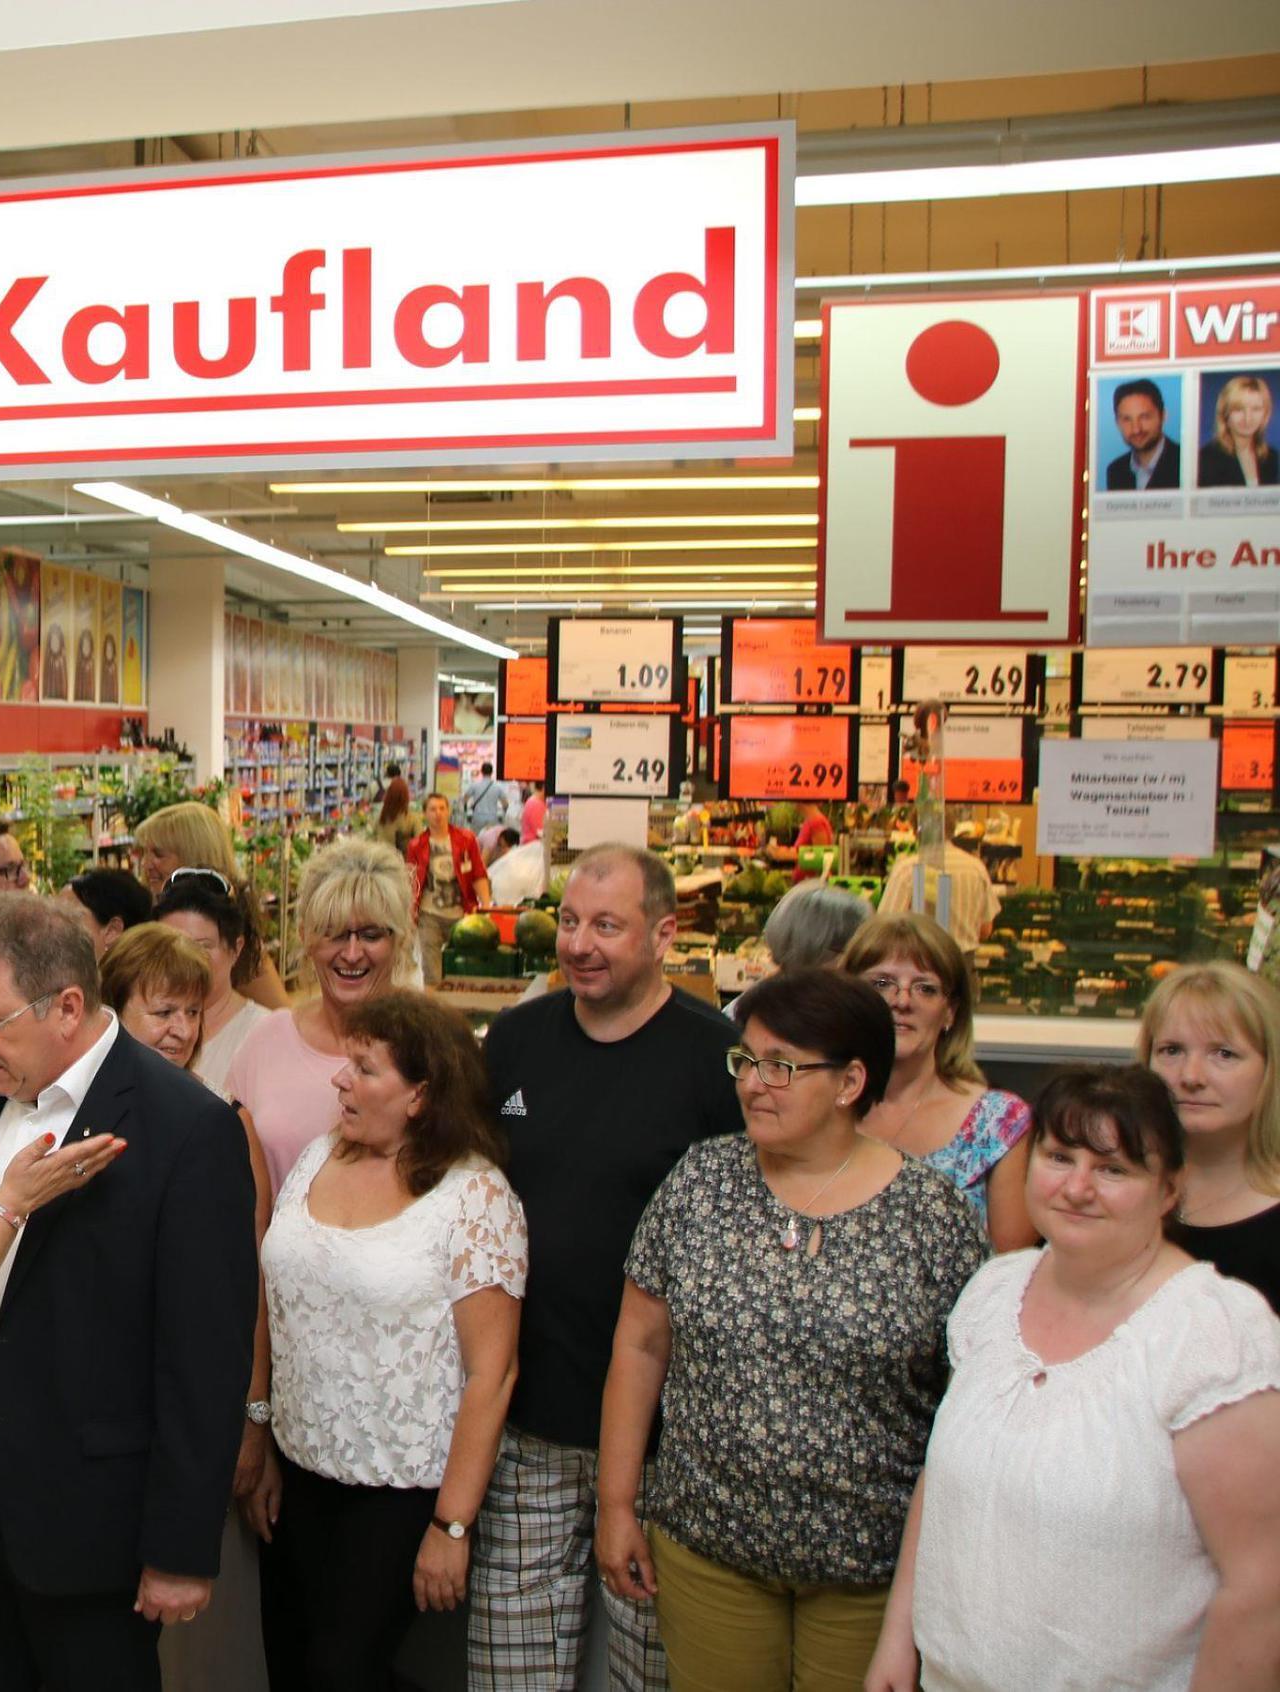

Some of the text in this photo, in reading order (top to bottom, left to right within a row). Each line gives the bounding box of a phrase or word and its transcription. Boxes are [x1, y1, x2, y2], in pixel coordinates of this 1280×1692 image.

[1184, 300, 1278, 345] Wir
[1146, 540, 1217, 570] Ihre
[618, 663, 669, 690] 1.09
[794, 666, 846, 697] 1.79
[965, 664, 1023, 697] 2.69
[1147, 663, 1208, 689] 2.79
[612, 758, 666, 784] 2.49
[788, 762, 844, 789] 2.99
[1070, 772, 1139, 784] Mitarbeiter
[982, 780, 1019, 793] 2.69
[1070, 790, 1169, 804] Wagenschieber
[1106, 805, 1150, 817] Teilzeit
[501, 1105, 528, 1117] adidas
